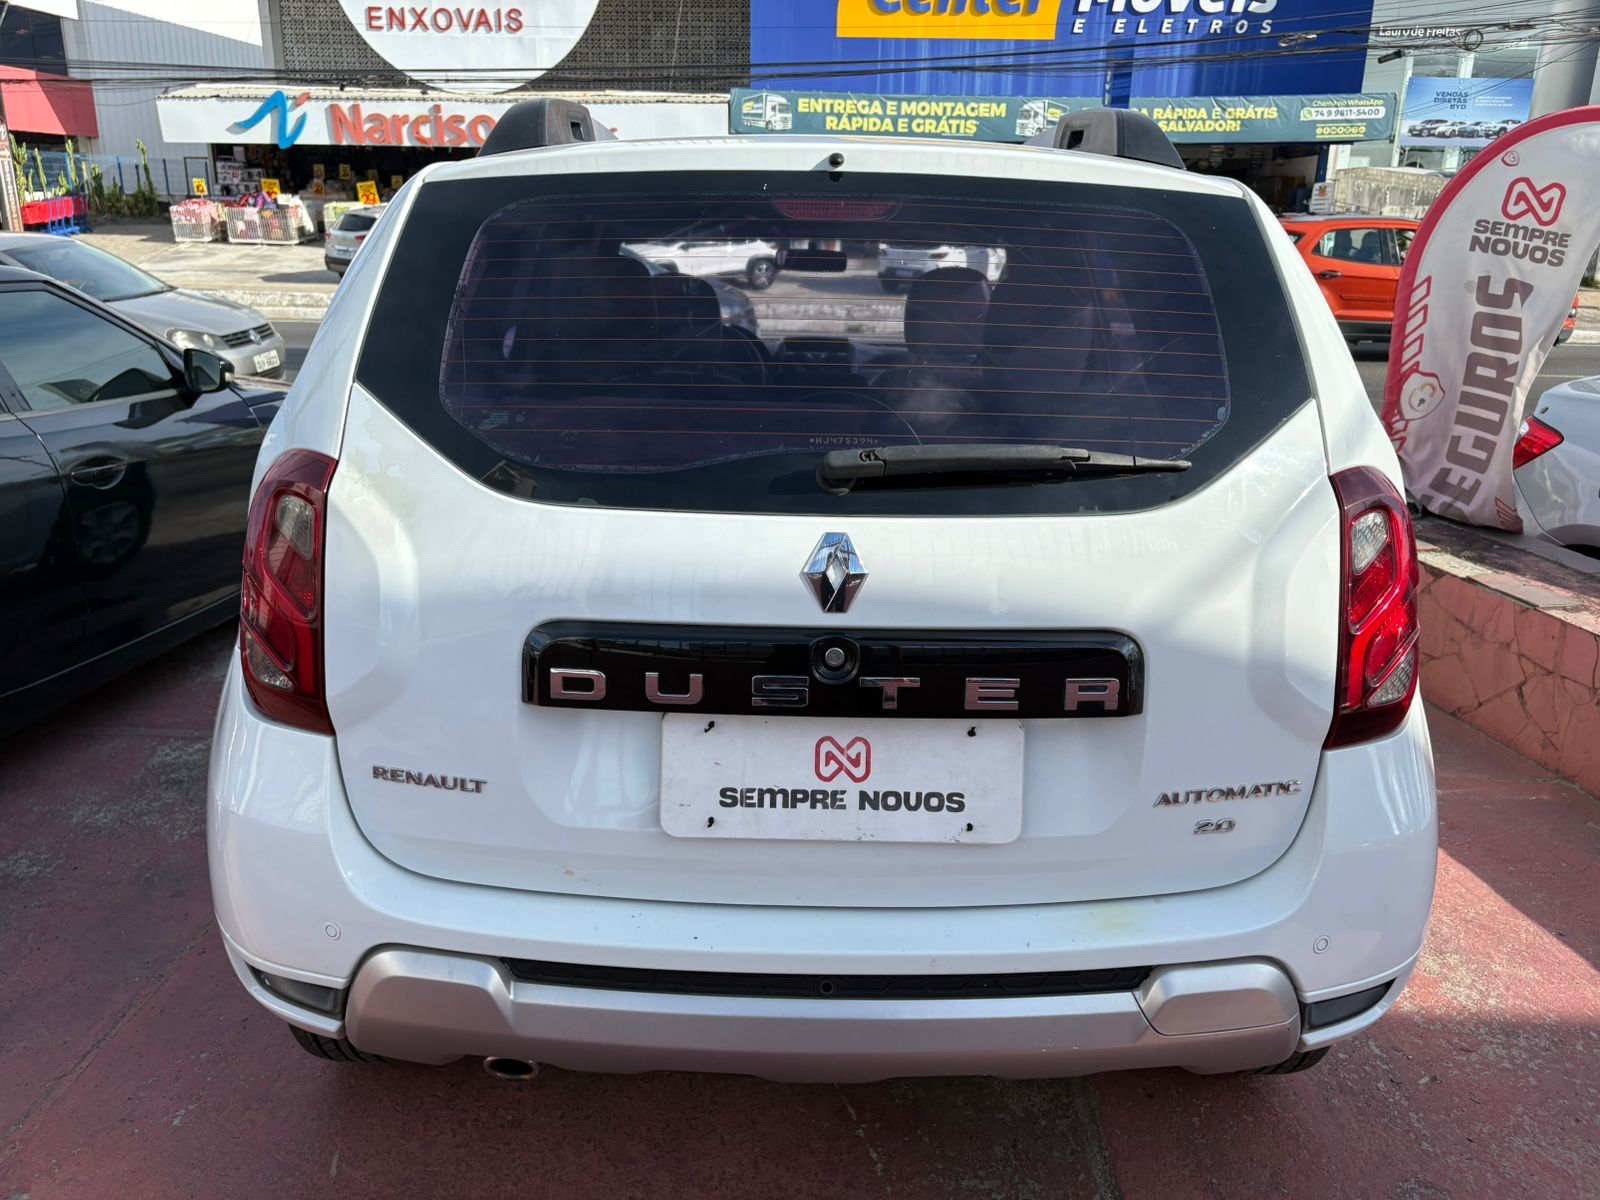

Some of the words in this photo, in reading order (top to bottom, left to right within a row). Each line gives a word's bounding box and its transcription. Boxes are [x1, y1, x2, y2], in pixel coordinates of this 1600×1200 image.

[365, 7, 524, 32] ENXOVAIS
[1073, 18, 1086, 34] E
[1114, 18, 1272, 34] ELETROS
[1379, 26, 1409, 36] Lauro
[1411, 26, 1424, 36] de
[1426, 26, 1461, 37] Freitas
[798, 98, 883, 115] ENTREGA
[886, 101, 898, 115] E
[901, 102, 1007, 118] MONTAGEM
[1153, 105, 1208, 120] RÁPIDA
[1213, 107, 1222, 120] E
[1224, 105, 1279, 120] GRÁTIS
[1314, 109, 1325, 118] 74
[1326, 109, 1333, 117] 9
[1347, 99, 1384, 107] WhatsApp
[330, 103, 497, 146] Narciso
[826, 114, 894, 132] RÁPIDA
[898, 118, 909, 133] E
[1158, 119, 1241, 132] SALVADOR!
[1473, 218, 1572, 250] SEMPRE
[1469, 234, 1566, 268] NOVOS
[549, 667, 1120, 711] DUSTER
[372, 765, 488, 794] RENAULT
[718, 785, 847, 811] SEMPRE
[858, 790, 967, 814] NOVOS
[1152, 779, 1303, 808] AUTOMATIC
